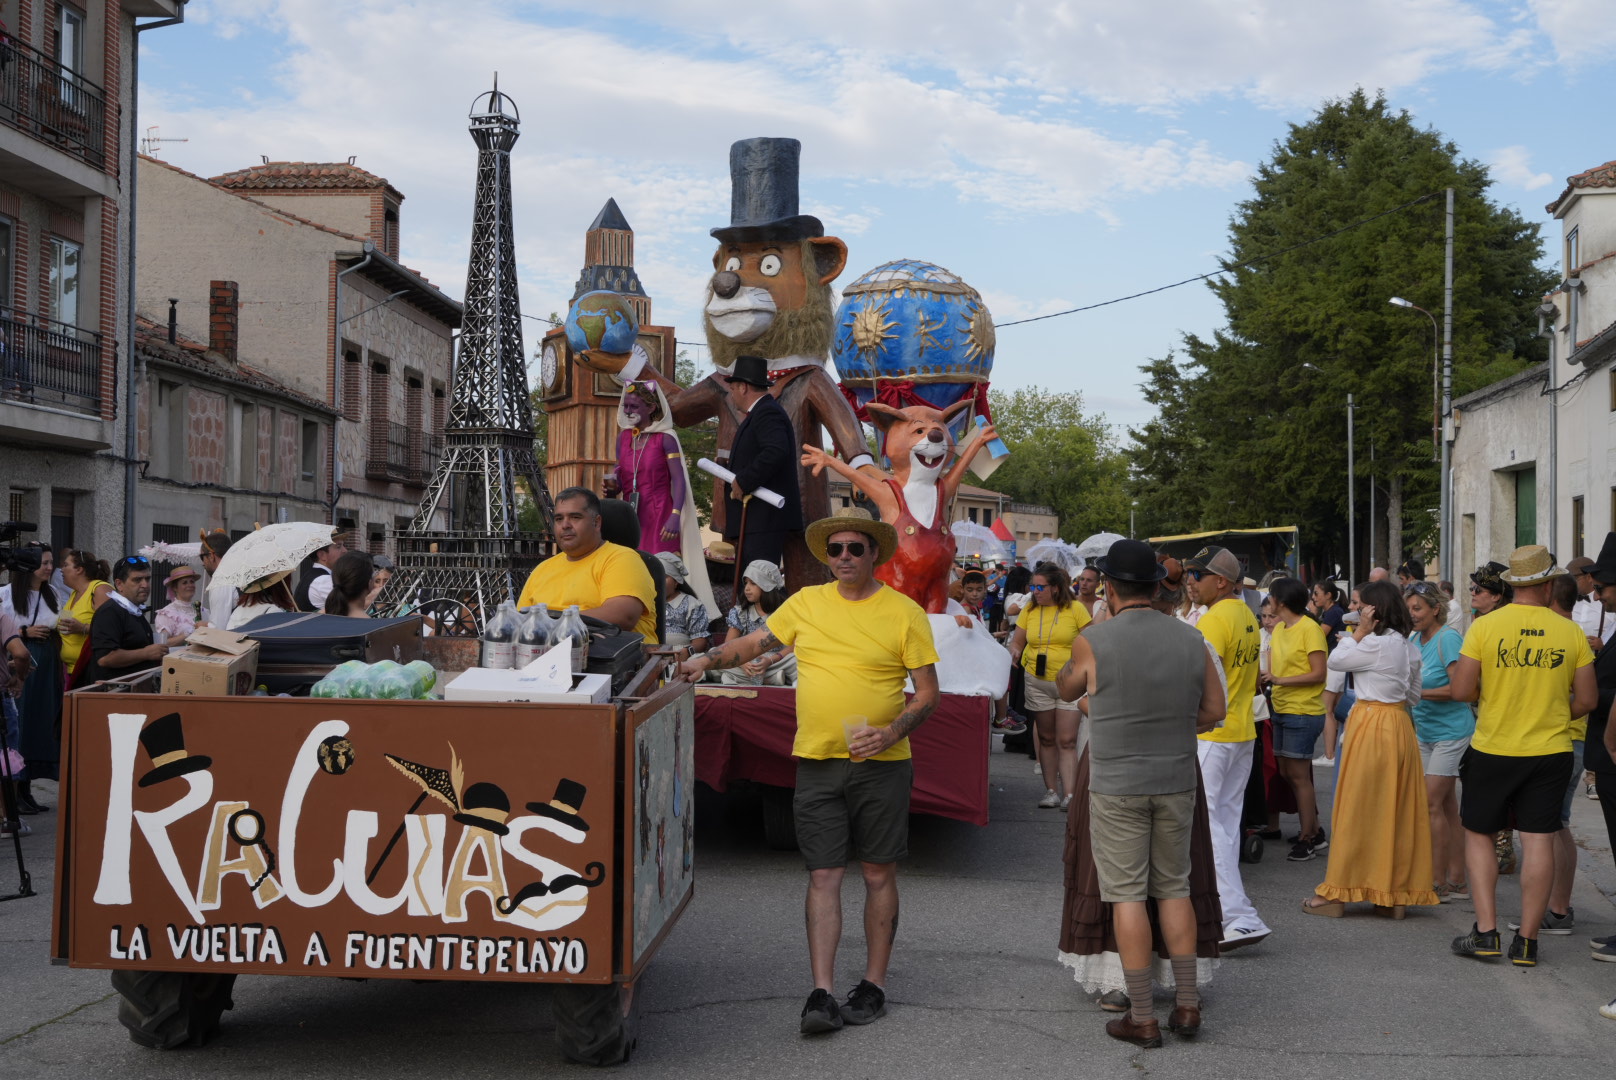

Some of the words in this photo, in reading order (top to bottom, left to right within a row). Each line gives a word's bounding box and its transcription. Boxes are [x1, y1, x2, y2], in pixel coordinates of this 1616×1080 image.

[109, 924, 151, 961] LA
[166, 923, 287, 964] VUELTA
[302, 930, 331, 967] A
[344, 930, 588, 975] FUENTEPELAYO
